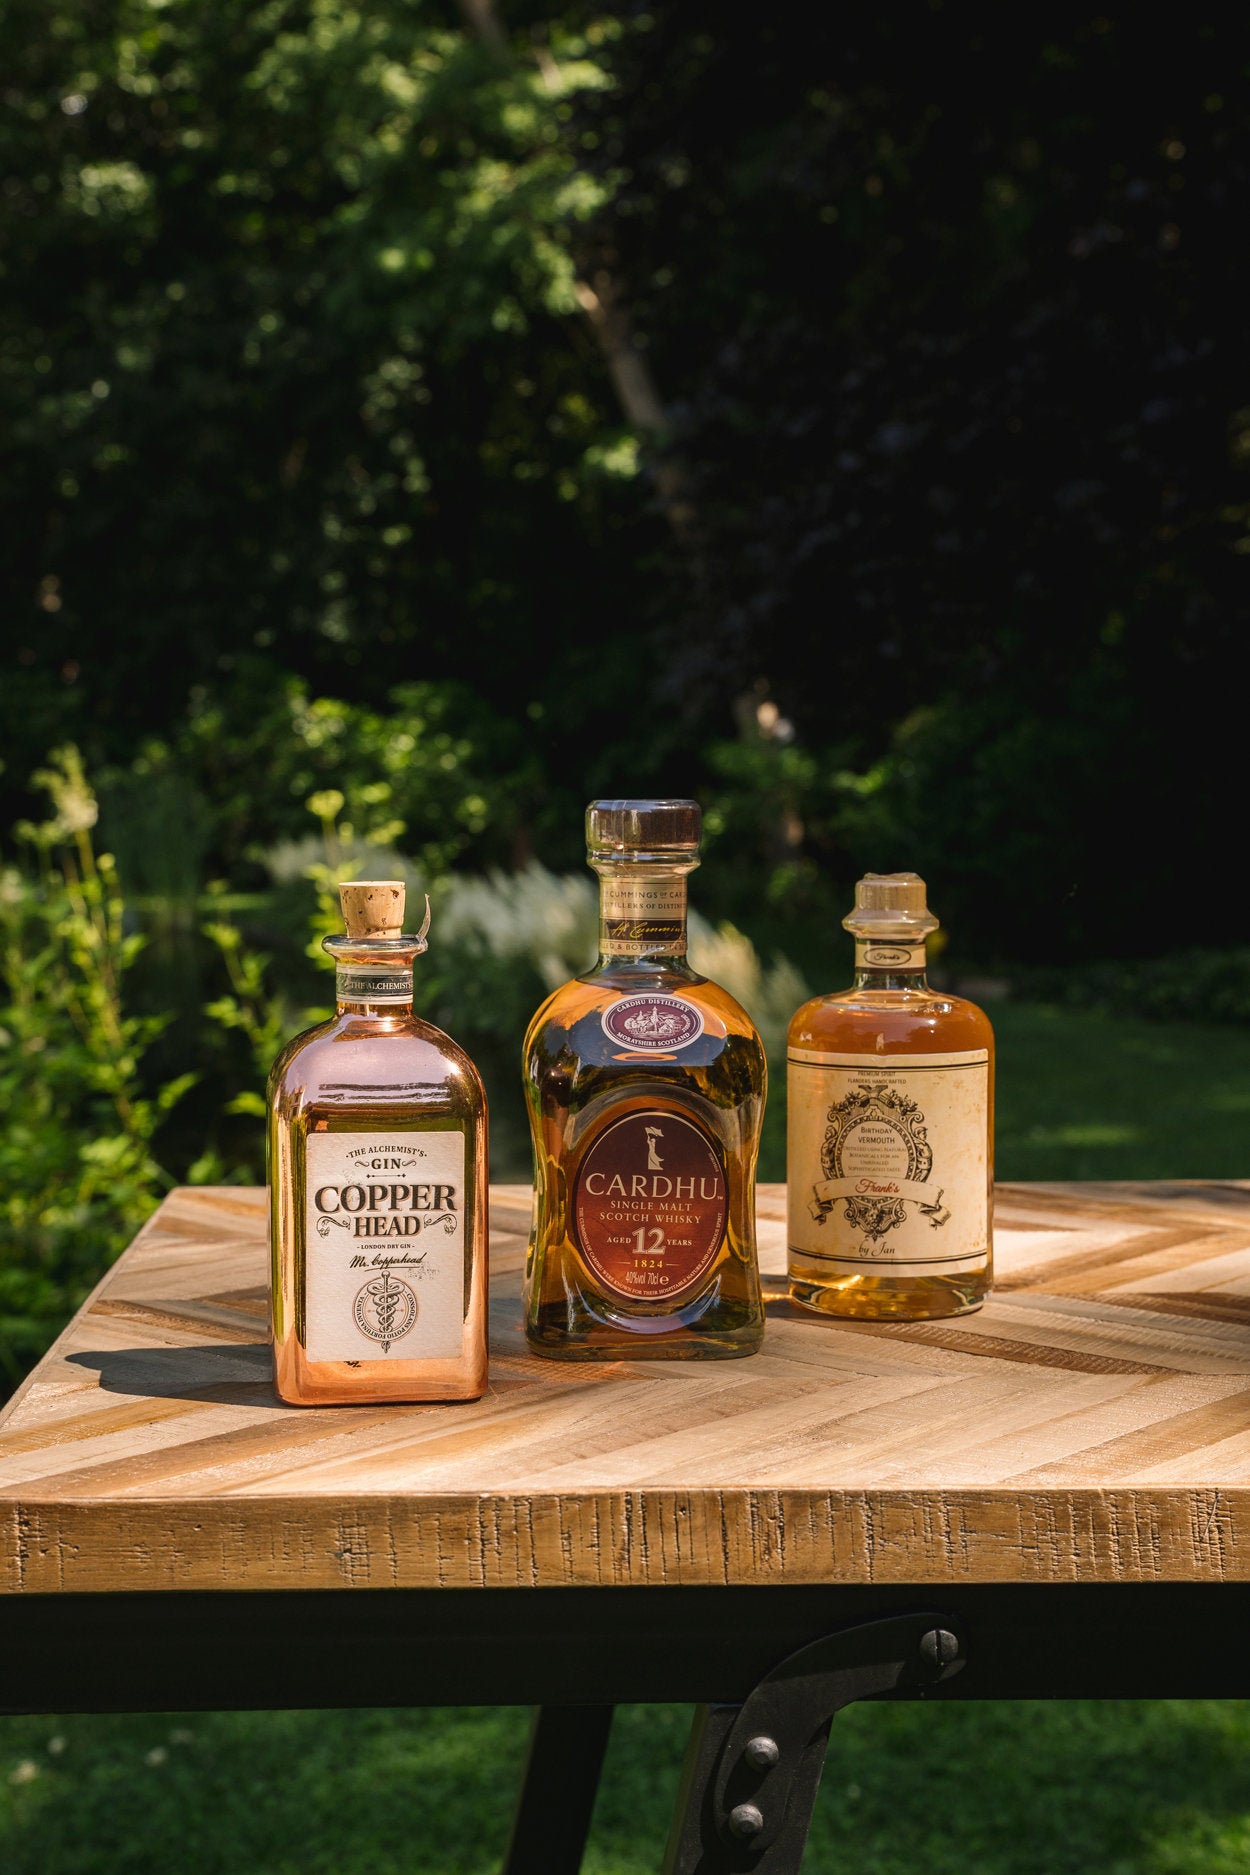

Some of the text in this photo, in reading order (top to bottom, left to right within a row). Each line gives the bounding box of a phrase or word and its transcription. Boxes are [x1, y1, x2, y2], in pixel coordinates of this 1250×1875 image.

[616, 999, 689, 1012] CARDHU DISTILLERY
[616, 1032, 690, 1046] MORAYSHIRE SCOTLAND
[348, 1146, 424, 1158] THE ALCHEMIST'S
[372, 1158, 402, 1170] GIN
[586, 1172, 718, 1200] CARDHU
[855, 1178, 900, 1194] Frank's
[314, 1184, 458, 1213] COPPER
[610, 1200, 692, 1212] SINGLE MALT
[353, 1215, 421, 1237] HEAD
[600, 1212, 701, 1224] SCOTCH WHISKY
[632, 1226, 666, 1256] 12
[859, 1240, 895, 1256] by Jan
[350, 1252, 428, 1270] Mr. Copperhead
[634, 1260, 664, 1268] 1824
[405, 1293, 416, 1328] CONSOLANS
[361, 1321, 386, 1340] FORTUNA
